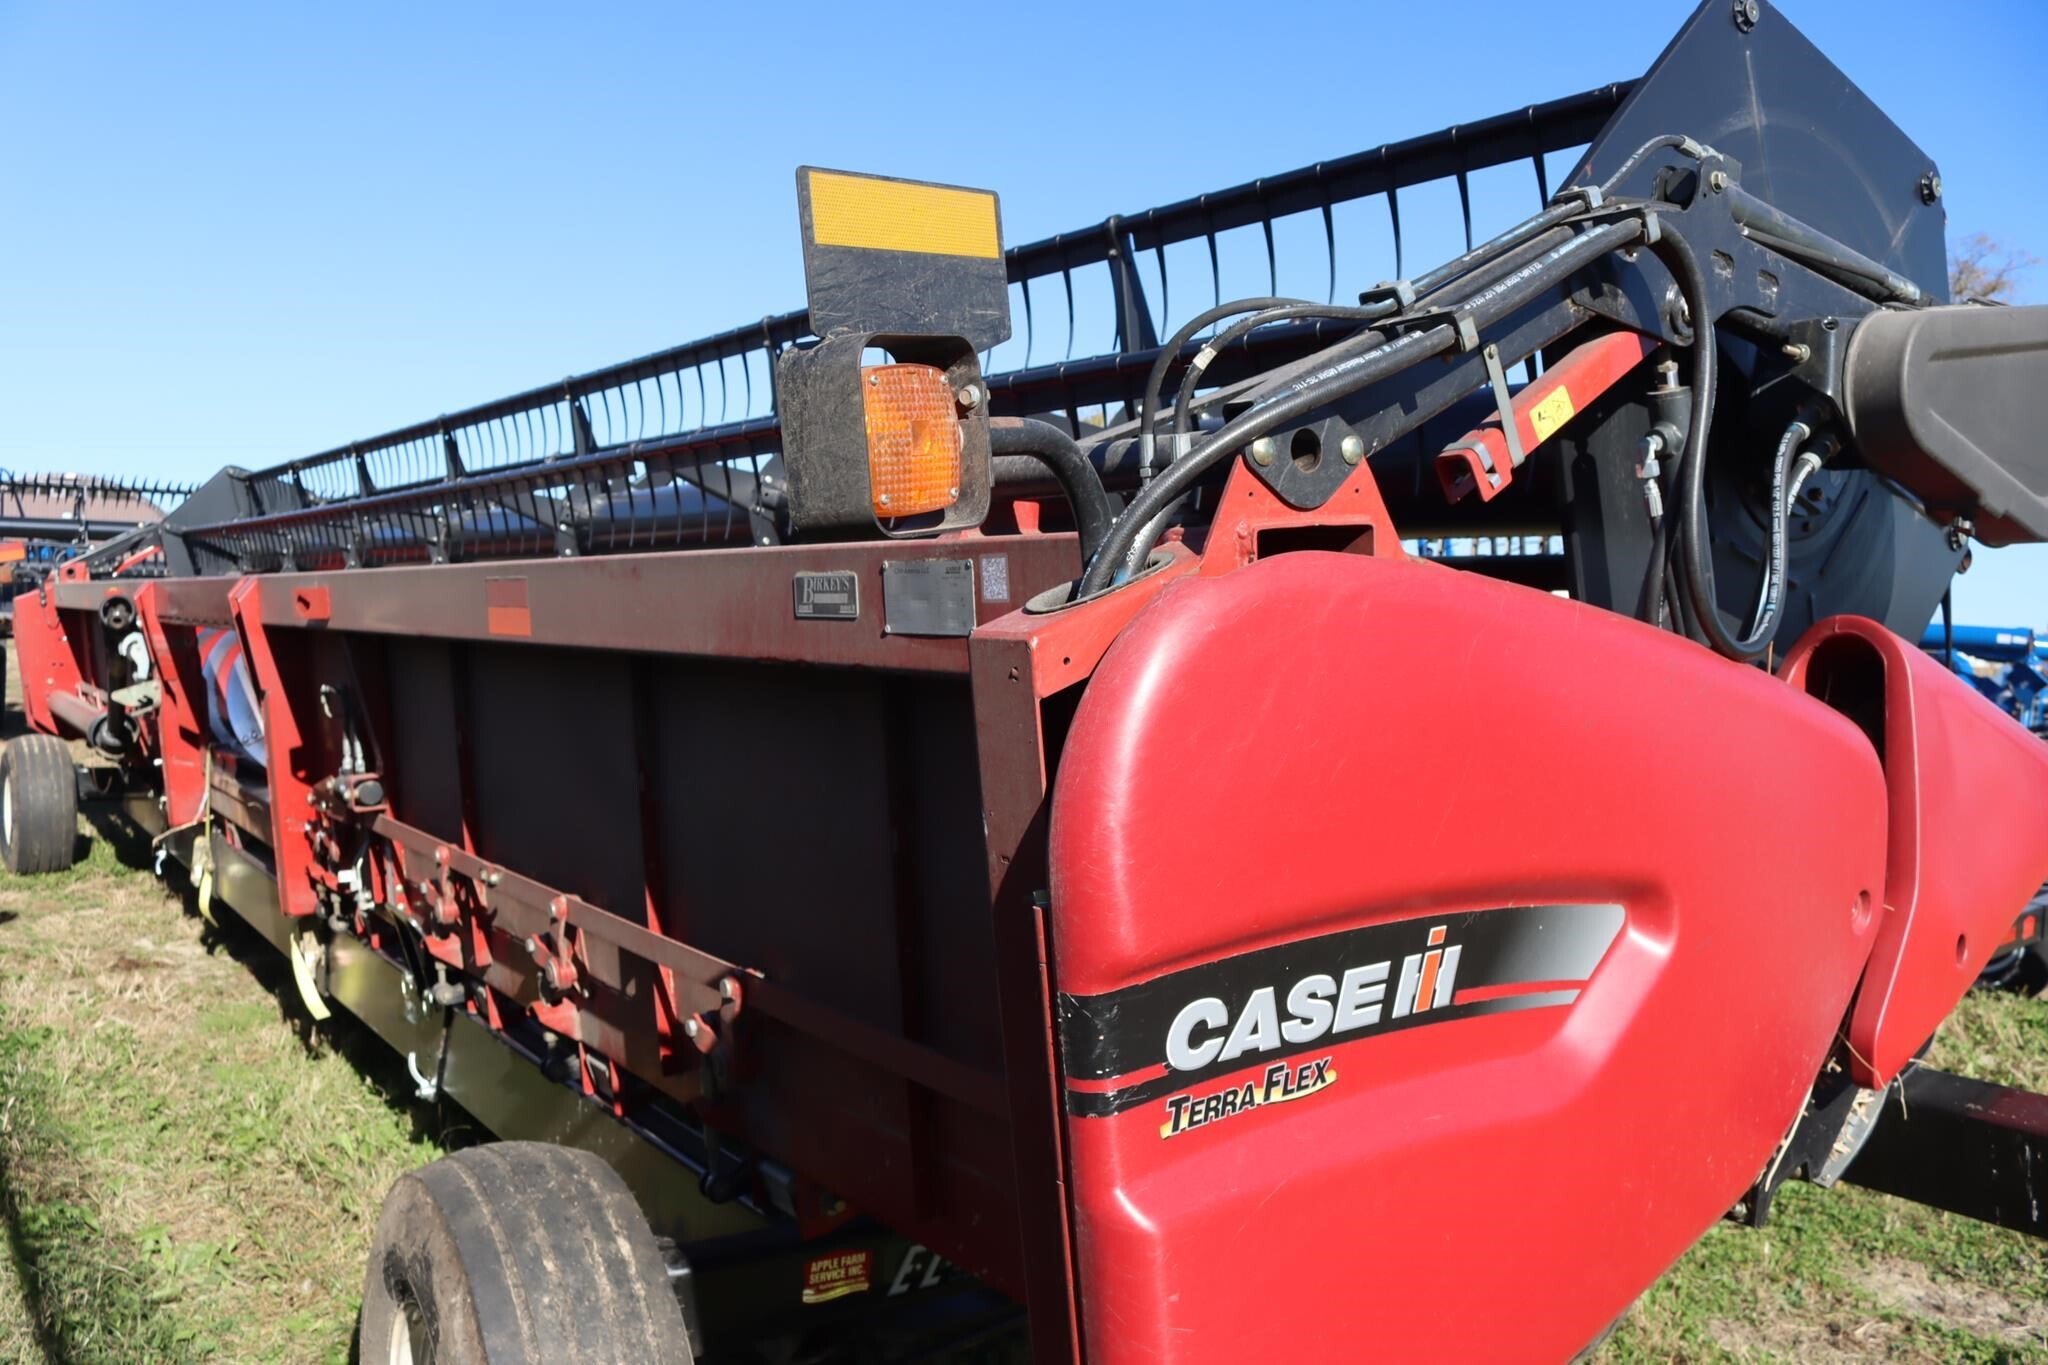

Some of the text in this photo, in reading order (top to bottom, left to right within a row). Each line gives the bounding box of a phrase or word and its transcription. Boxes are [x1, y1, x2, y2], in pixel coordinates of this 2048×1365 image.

[802, 576, 849, 604] BIRKEY'S
[1165, 961, 1391, 1071] CASE
[1167, 1056, 1332, 1135] TERRA FLEX
[811, 1251, 867, 1272] APPLE FARM
[809, 1268, 846, 1284] SERVICE
